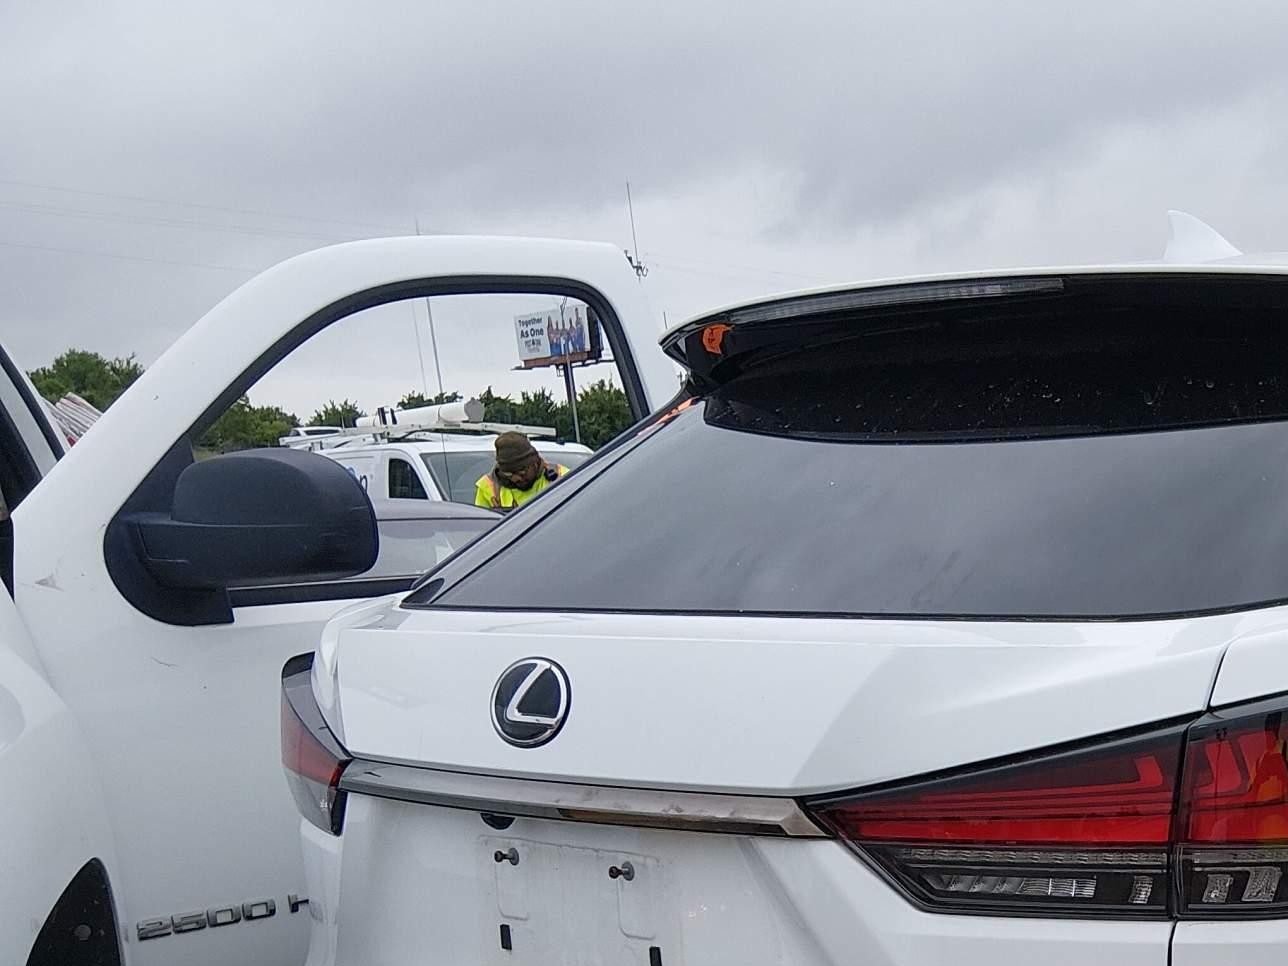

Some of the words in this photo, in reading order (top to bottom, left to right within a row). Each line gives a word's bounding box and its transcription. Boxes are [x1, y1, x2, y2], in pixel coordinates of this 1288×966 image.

[520, 329, 529, 339] As
[530, 327, 544, 337] One
[136, 899, 277, 941] 2500
